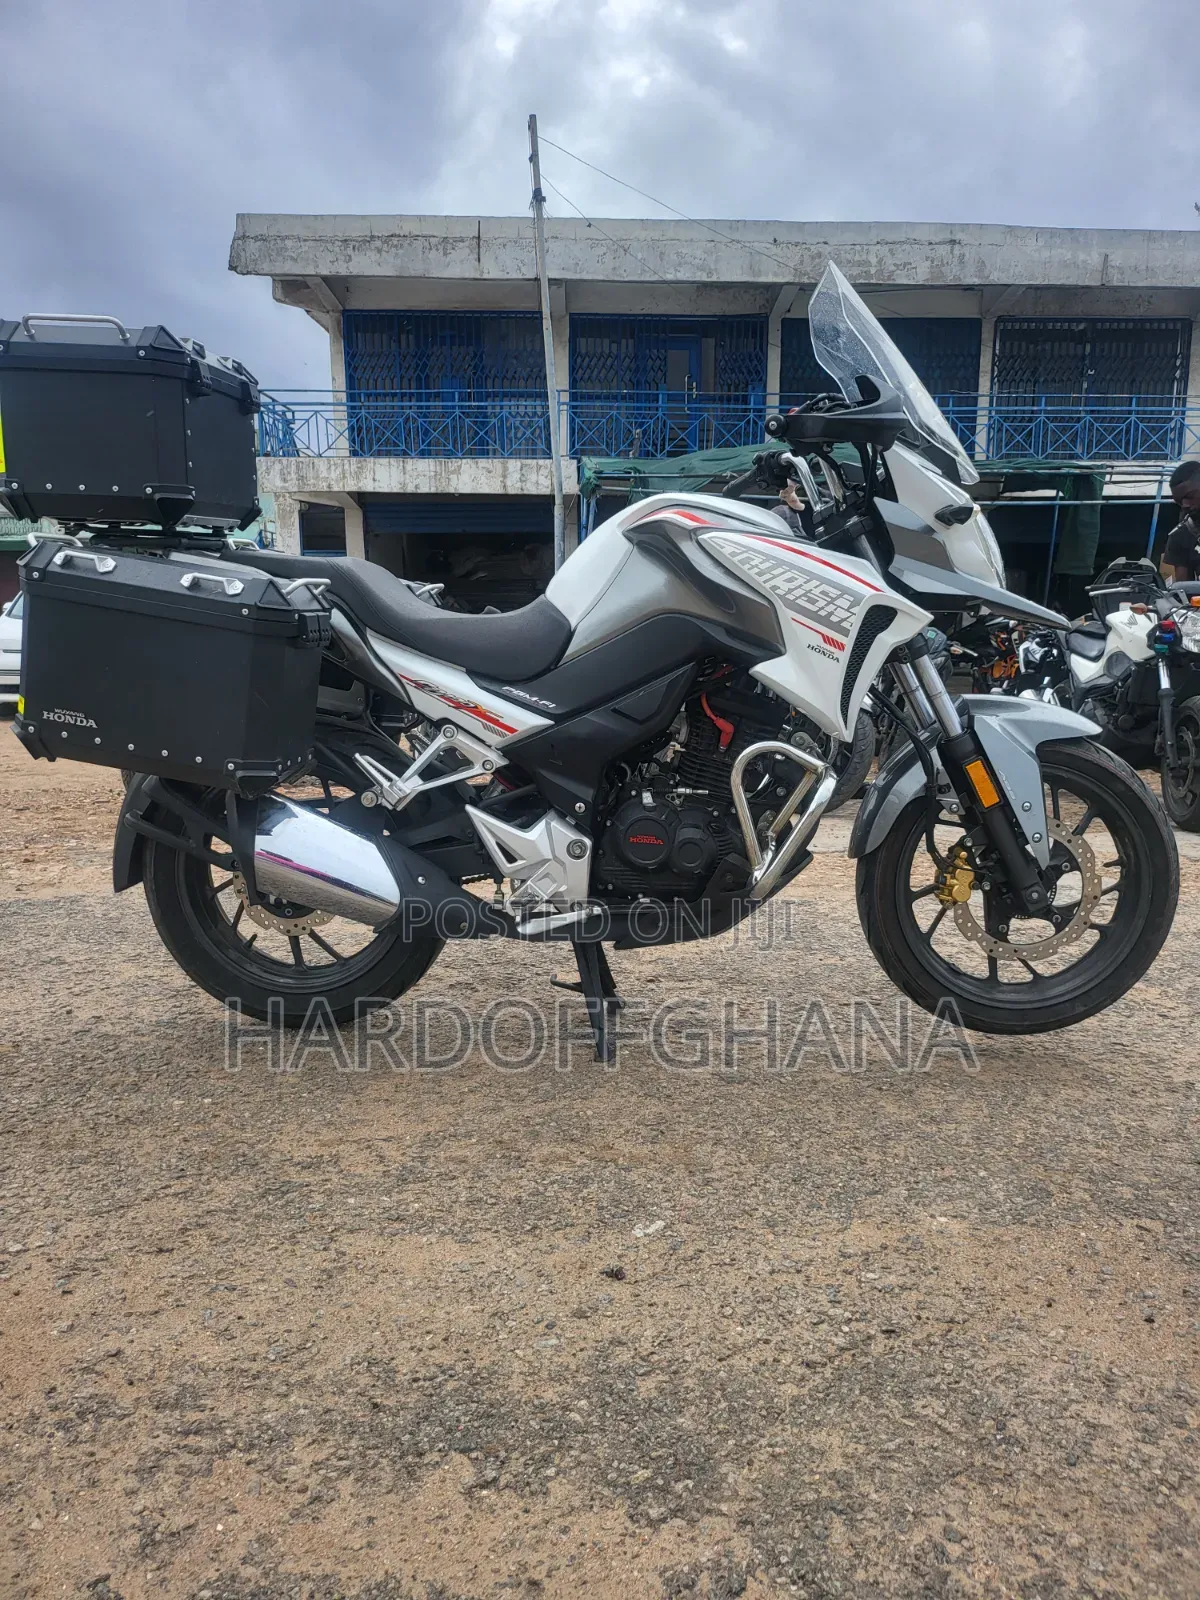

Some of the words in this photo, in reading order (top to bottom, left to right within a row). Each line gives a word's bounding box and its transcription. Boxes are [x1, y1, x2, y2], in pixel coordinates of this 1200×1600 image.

[806, 643, 840, 663] HONDA
[42, 710, 98, 728] HONDA
[54, 708, 85, 717] WUYANG
[629, 836, 664, 845] HONDA
